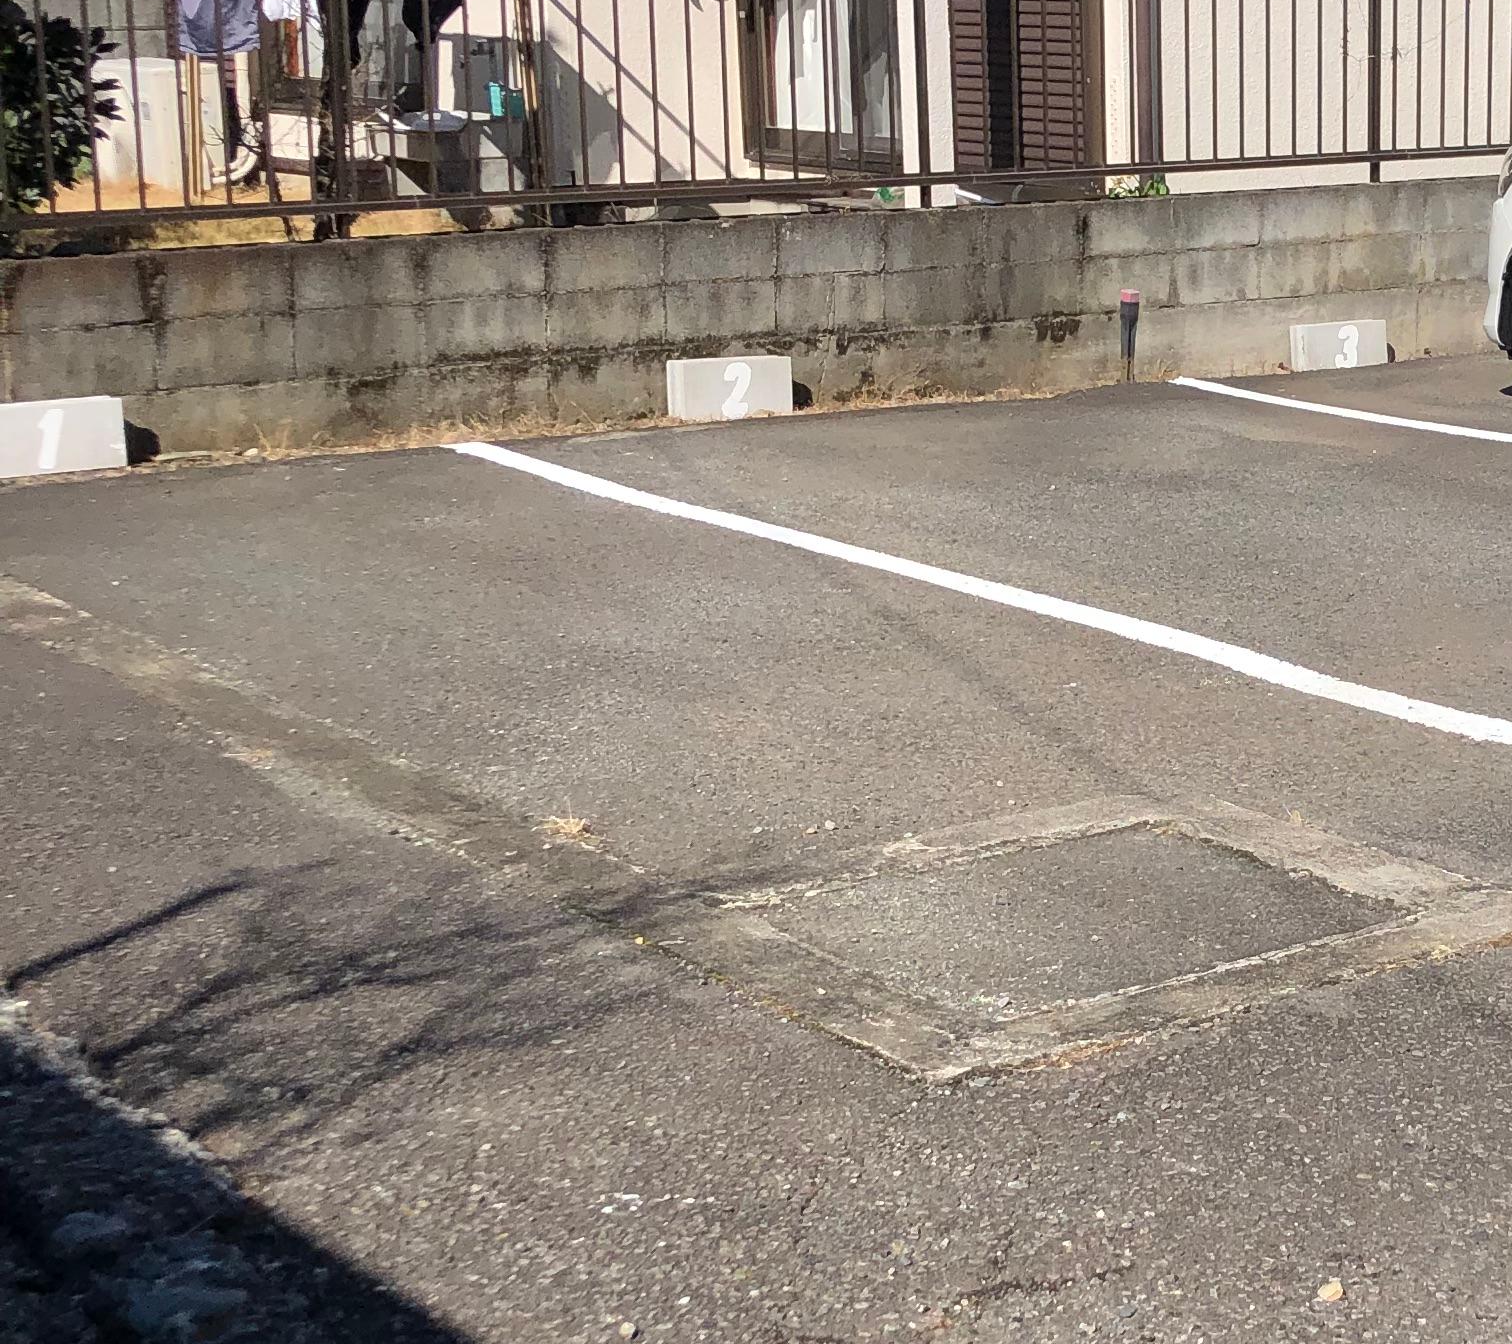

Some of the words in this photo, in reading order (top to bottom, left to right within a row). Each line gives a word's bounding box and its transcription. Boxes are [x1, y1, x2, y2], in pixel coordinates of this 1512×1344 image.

[1335, 324, 1359, 369] 3
[721, 361, 752, 419] 2
[37, 408, 65, 470] 1
